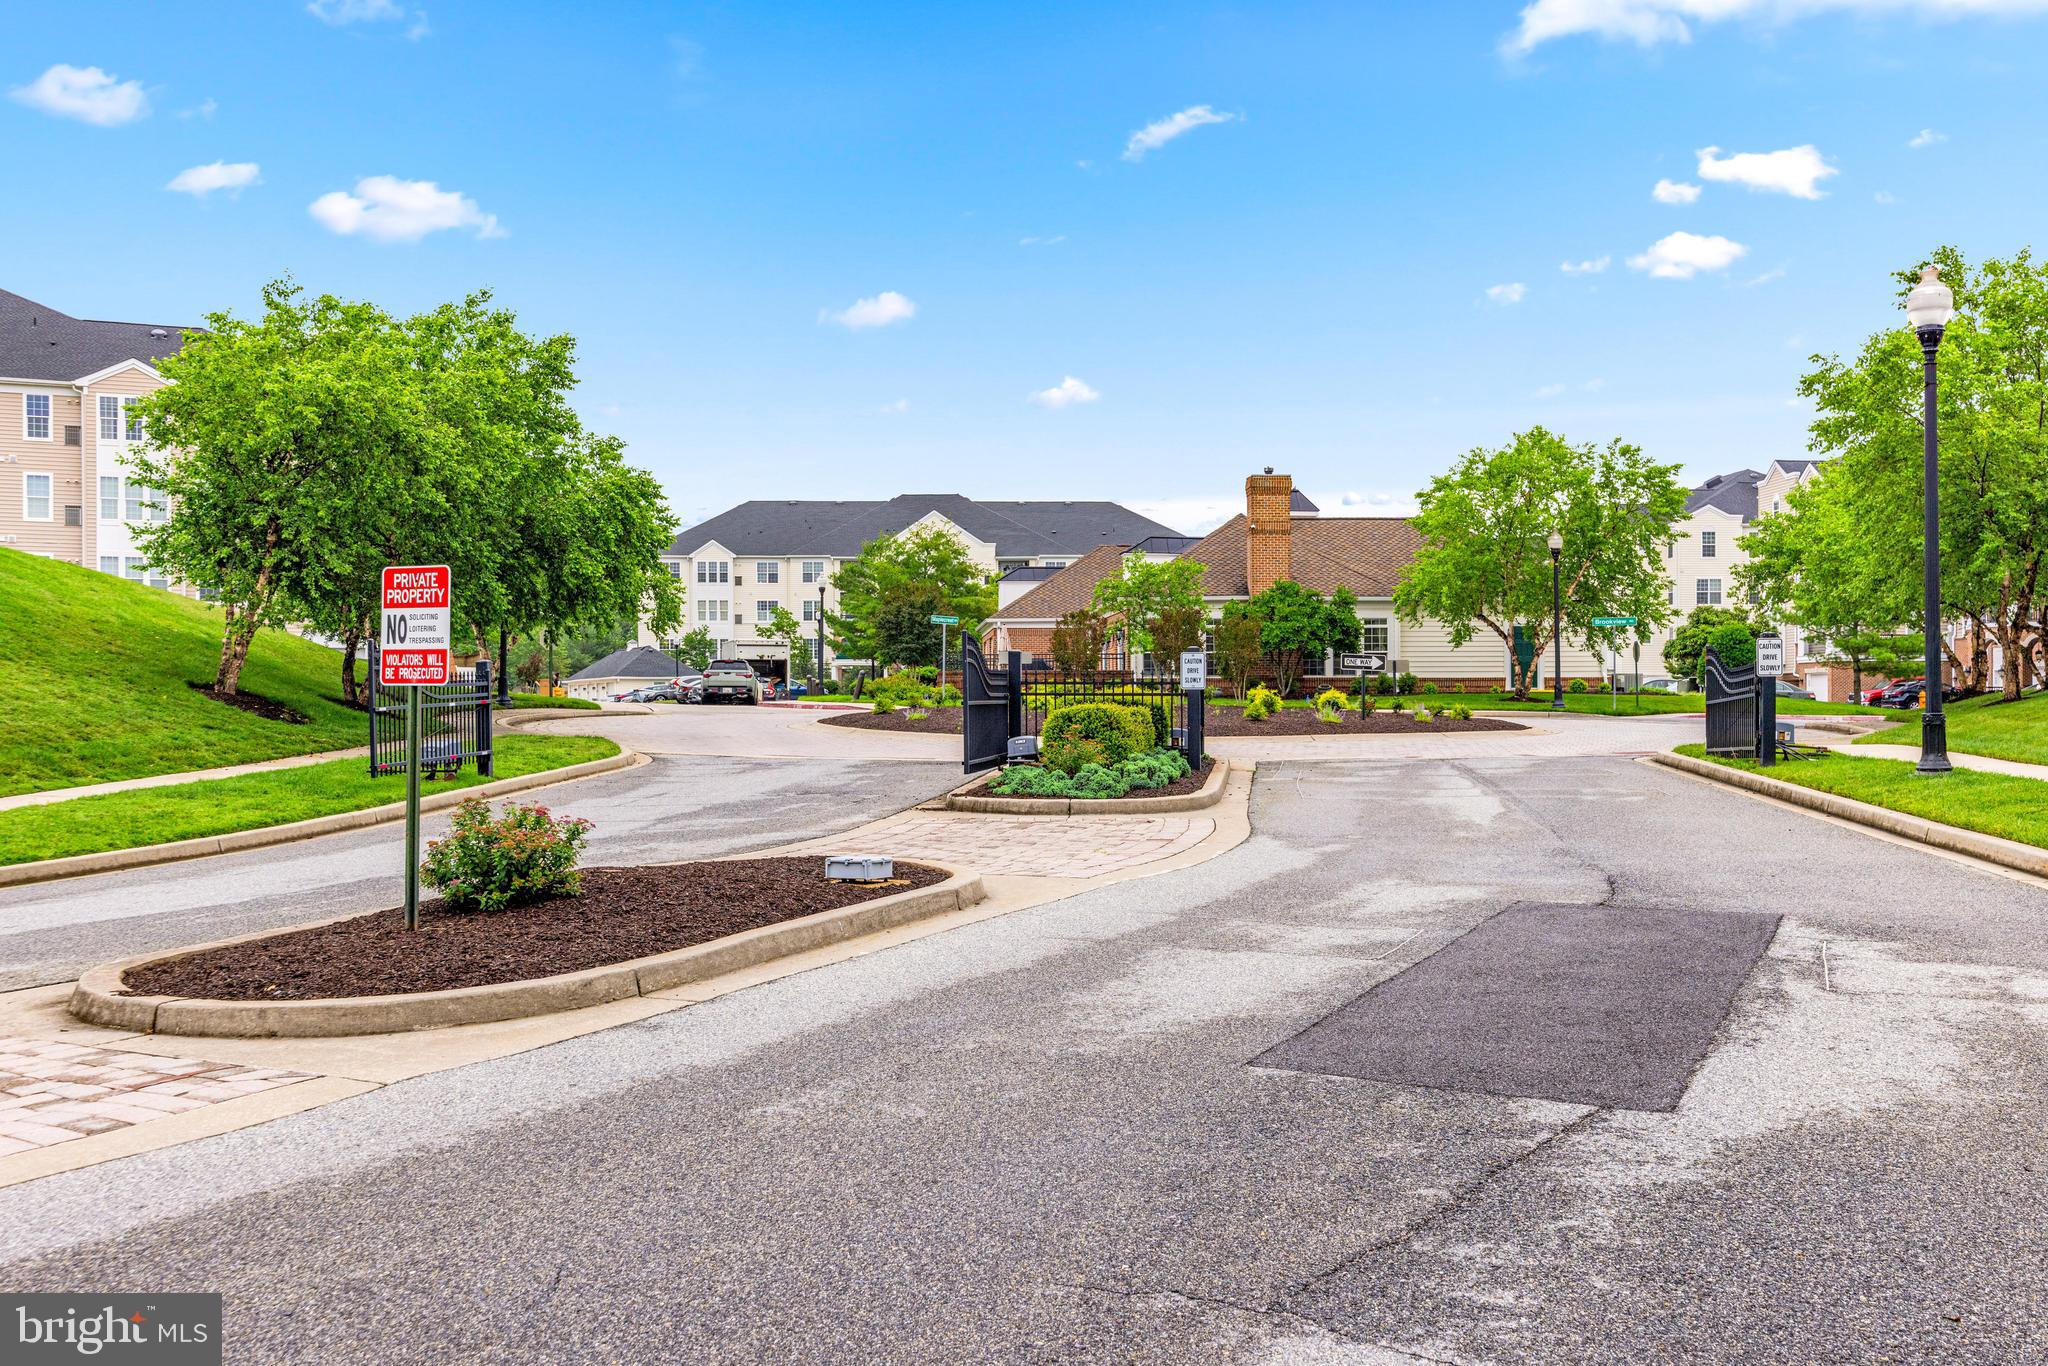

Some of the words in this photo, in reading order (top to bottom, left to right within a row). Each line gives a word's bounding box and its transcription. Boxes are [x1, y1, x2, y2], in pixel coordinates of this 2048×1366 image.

[393, 572, 438, 588] PRIVATE
[386, 588, 445, 604] PROPERTY
[409, 613, 439, 621] SOLICITING
[386, 614, 407, 645] NO
[385, 653, 424, 666] VIOLATORS
[427, 653, 444, 666] WILL
[384, 667, 395, 679] BE
[398, 667, 444, 680] PROSECUTED
